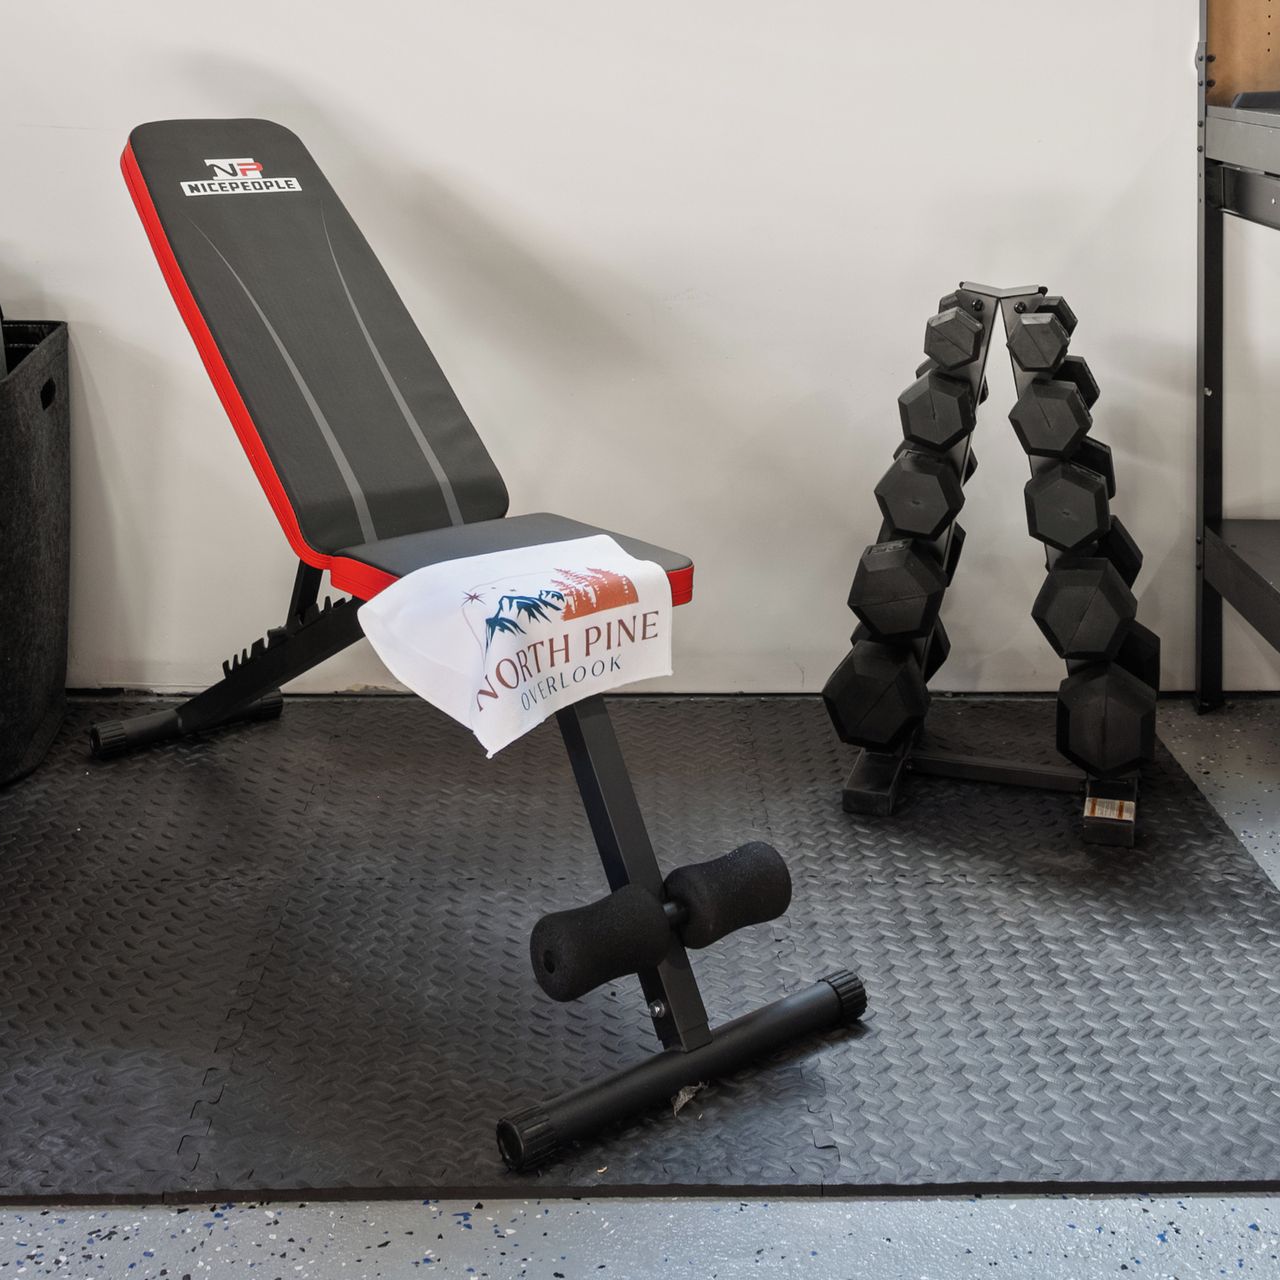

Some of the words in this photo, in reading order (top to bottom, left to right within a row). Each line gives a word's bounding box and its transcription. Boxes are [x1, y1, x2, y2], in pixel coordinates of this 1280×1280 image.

[187, 179, 297, 194] NICEPEOPLE
[475, 634, 571, 712] NORTH
[585, 611, 659, 657] PINE
[521, 653, 622, 711] OVERLOOK
